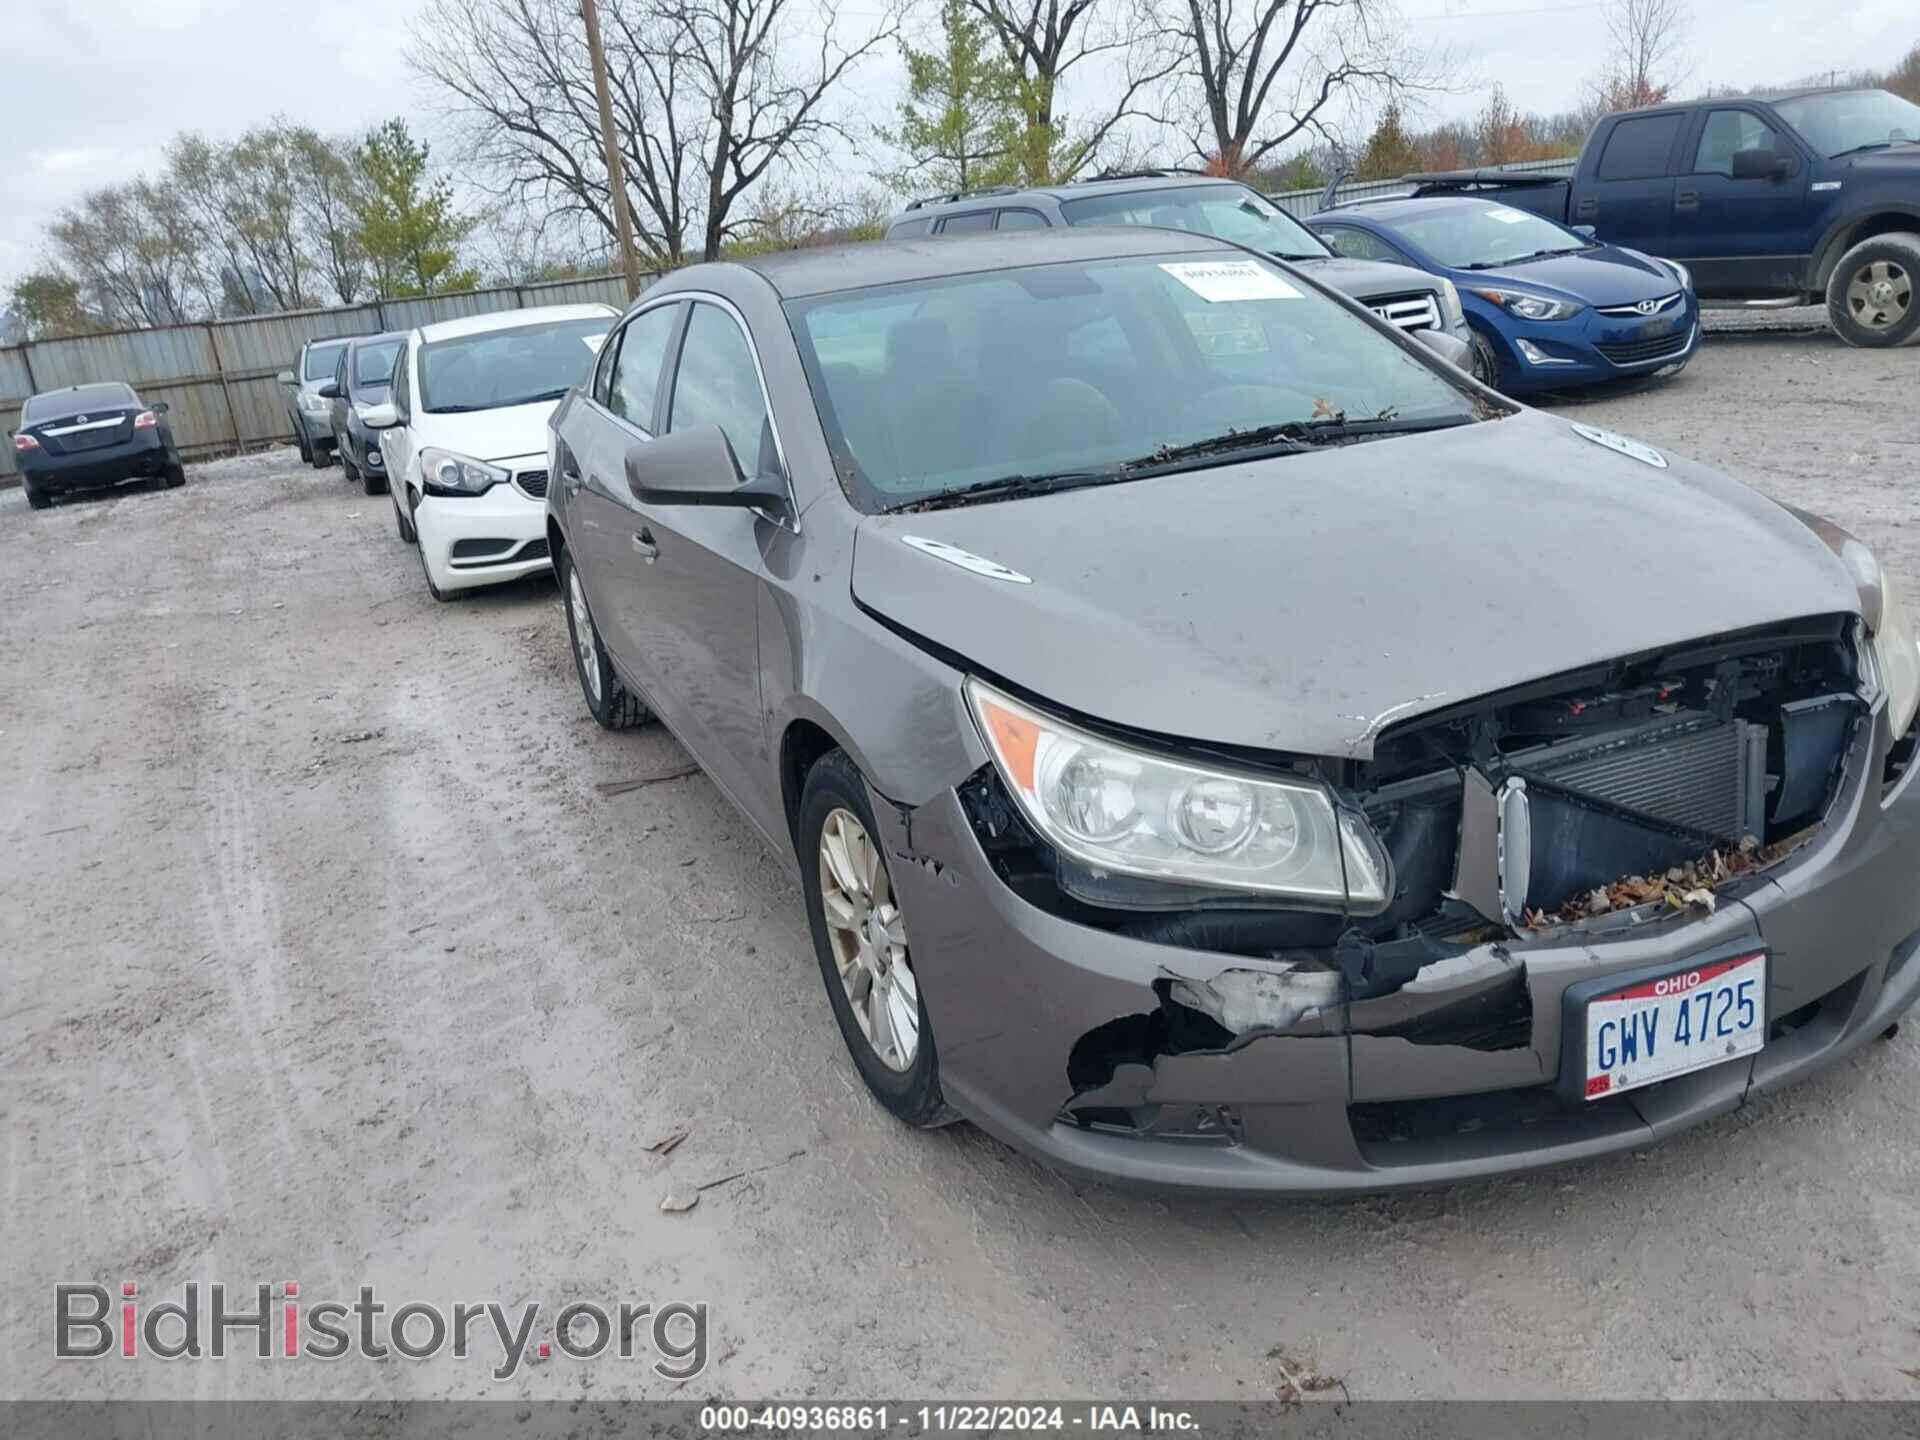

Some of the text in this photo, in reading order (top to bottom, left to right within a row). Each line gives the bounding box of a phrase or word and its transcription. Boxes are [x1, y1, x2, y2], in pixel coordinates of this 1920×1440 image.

[1654, 972, 1700, 995] OHIO
[1599, 979, 1755, 1070] GWV 4725
